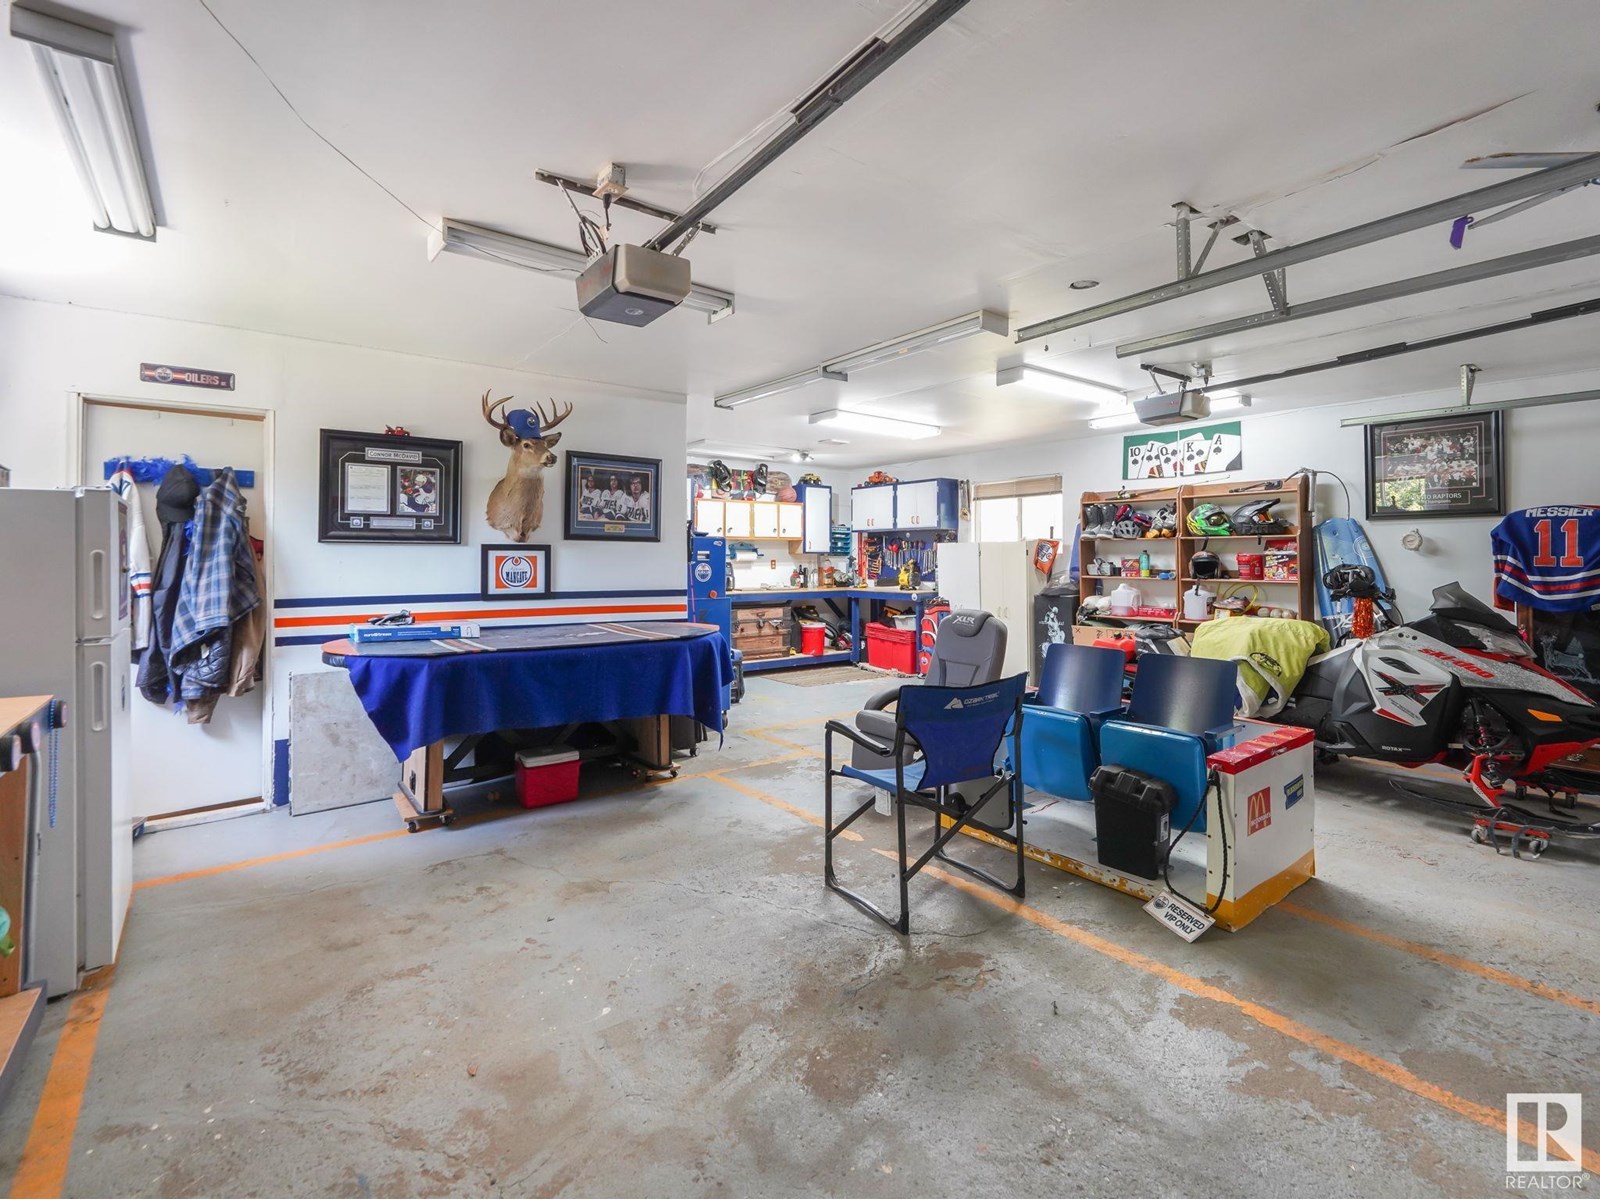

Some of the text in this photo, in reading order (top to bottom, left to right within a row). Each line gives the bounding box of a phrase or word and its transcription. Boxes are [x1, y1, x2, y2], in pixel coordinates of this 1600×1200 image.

[185, 372, 220, 386] OILERS
[1214, 434, 1222, 445] A
[1147, 443, 1154, 453] J
[1160, 446, 1169, 456] Q
[1186, 442, 1194, 452] K
[1432, 492, 1462, 500] RAPTORS
[1525, 507, 1594, 517] MESSIER
[1533, 519, 1584, 568] 11
[1381, 744, 1403, 753] ROTAX
[1168, 903, 1205, 930] RESERVED
[1164, 911, 1196, 935] VIP ONLY
